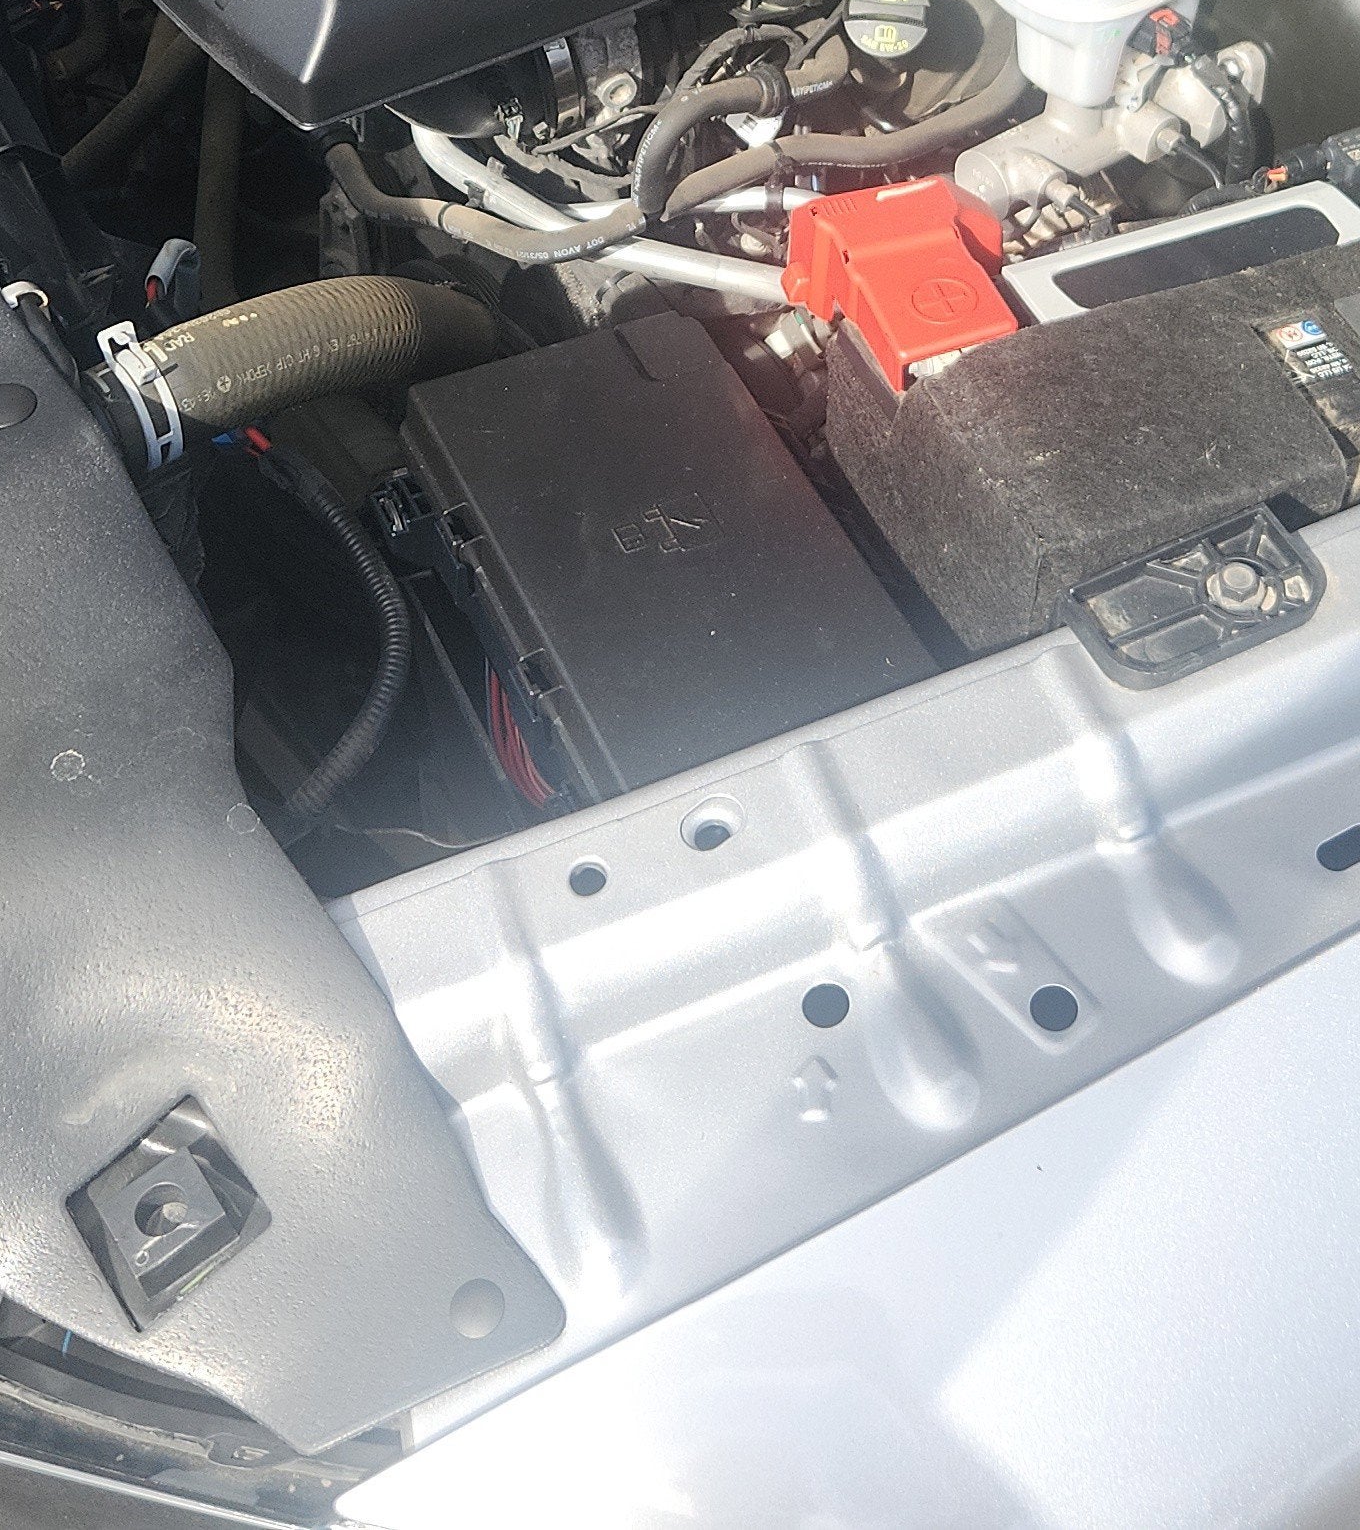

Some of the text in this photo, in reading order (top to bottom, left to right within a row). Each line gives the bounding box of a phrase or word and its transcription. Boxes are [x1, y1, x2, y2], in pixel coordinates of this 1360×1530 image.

[587, 236, 604, 250] DOT
[554, 244, 581, 258] AVON
[165, 331, 195, 351] RAD
